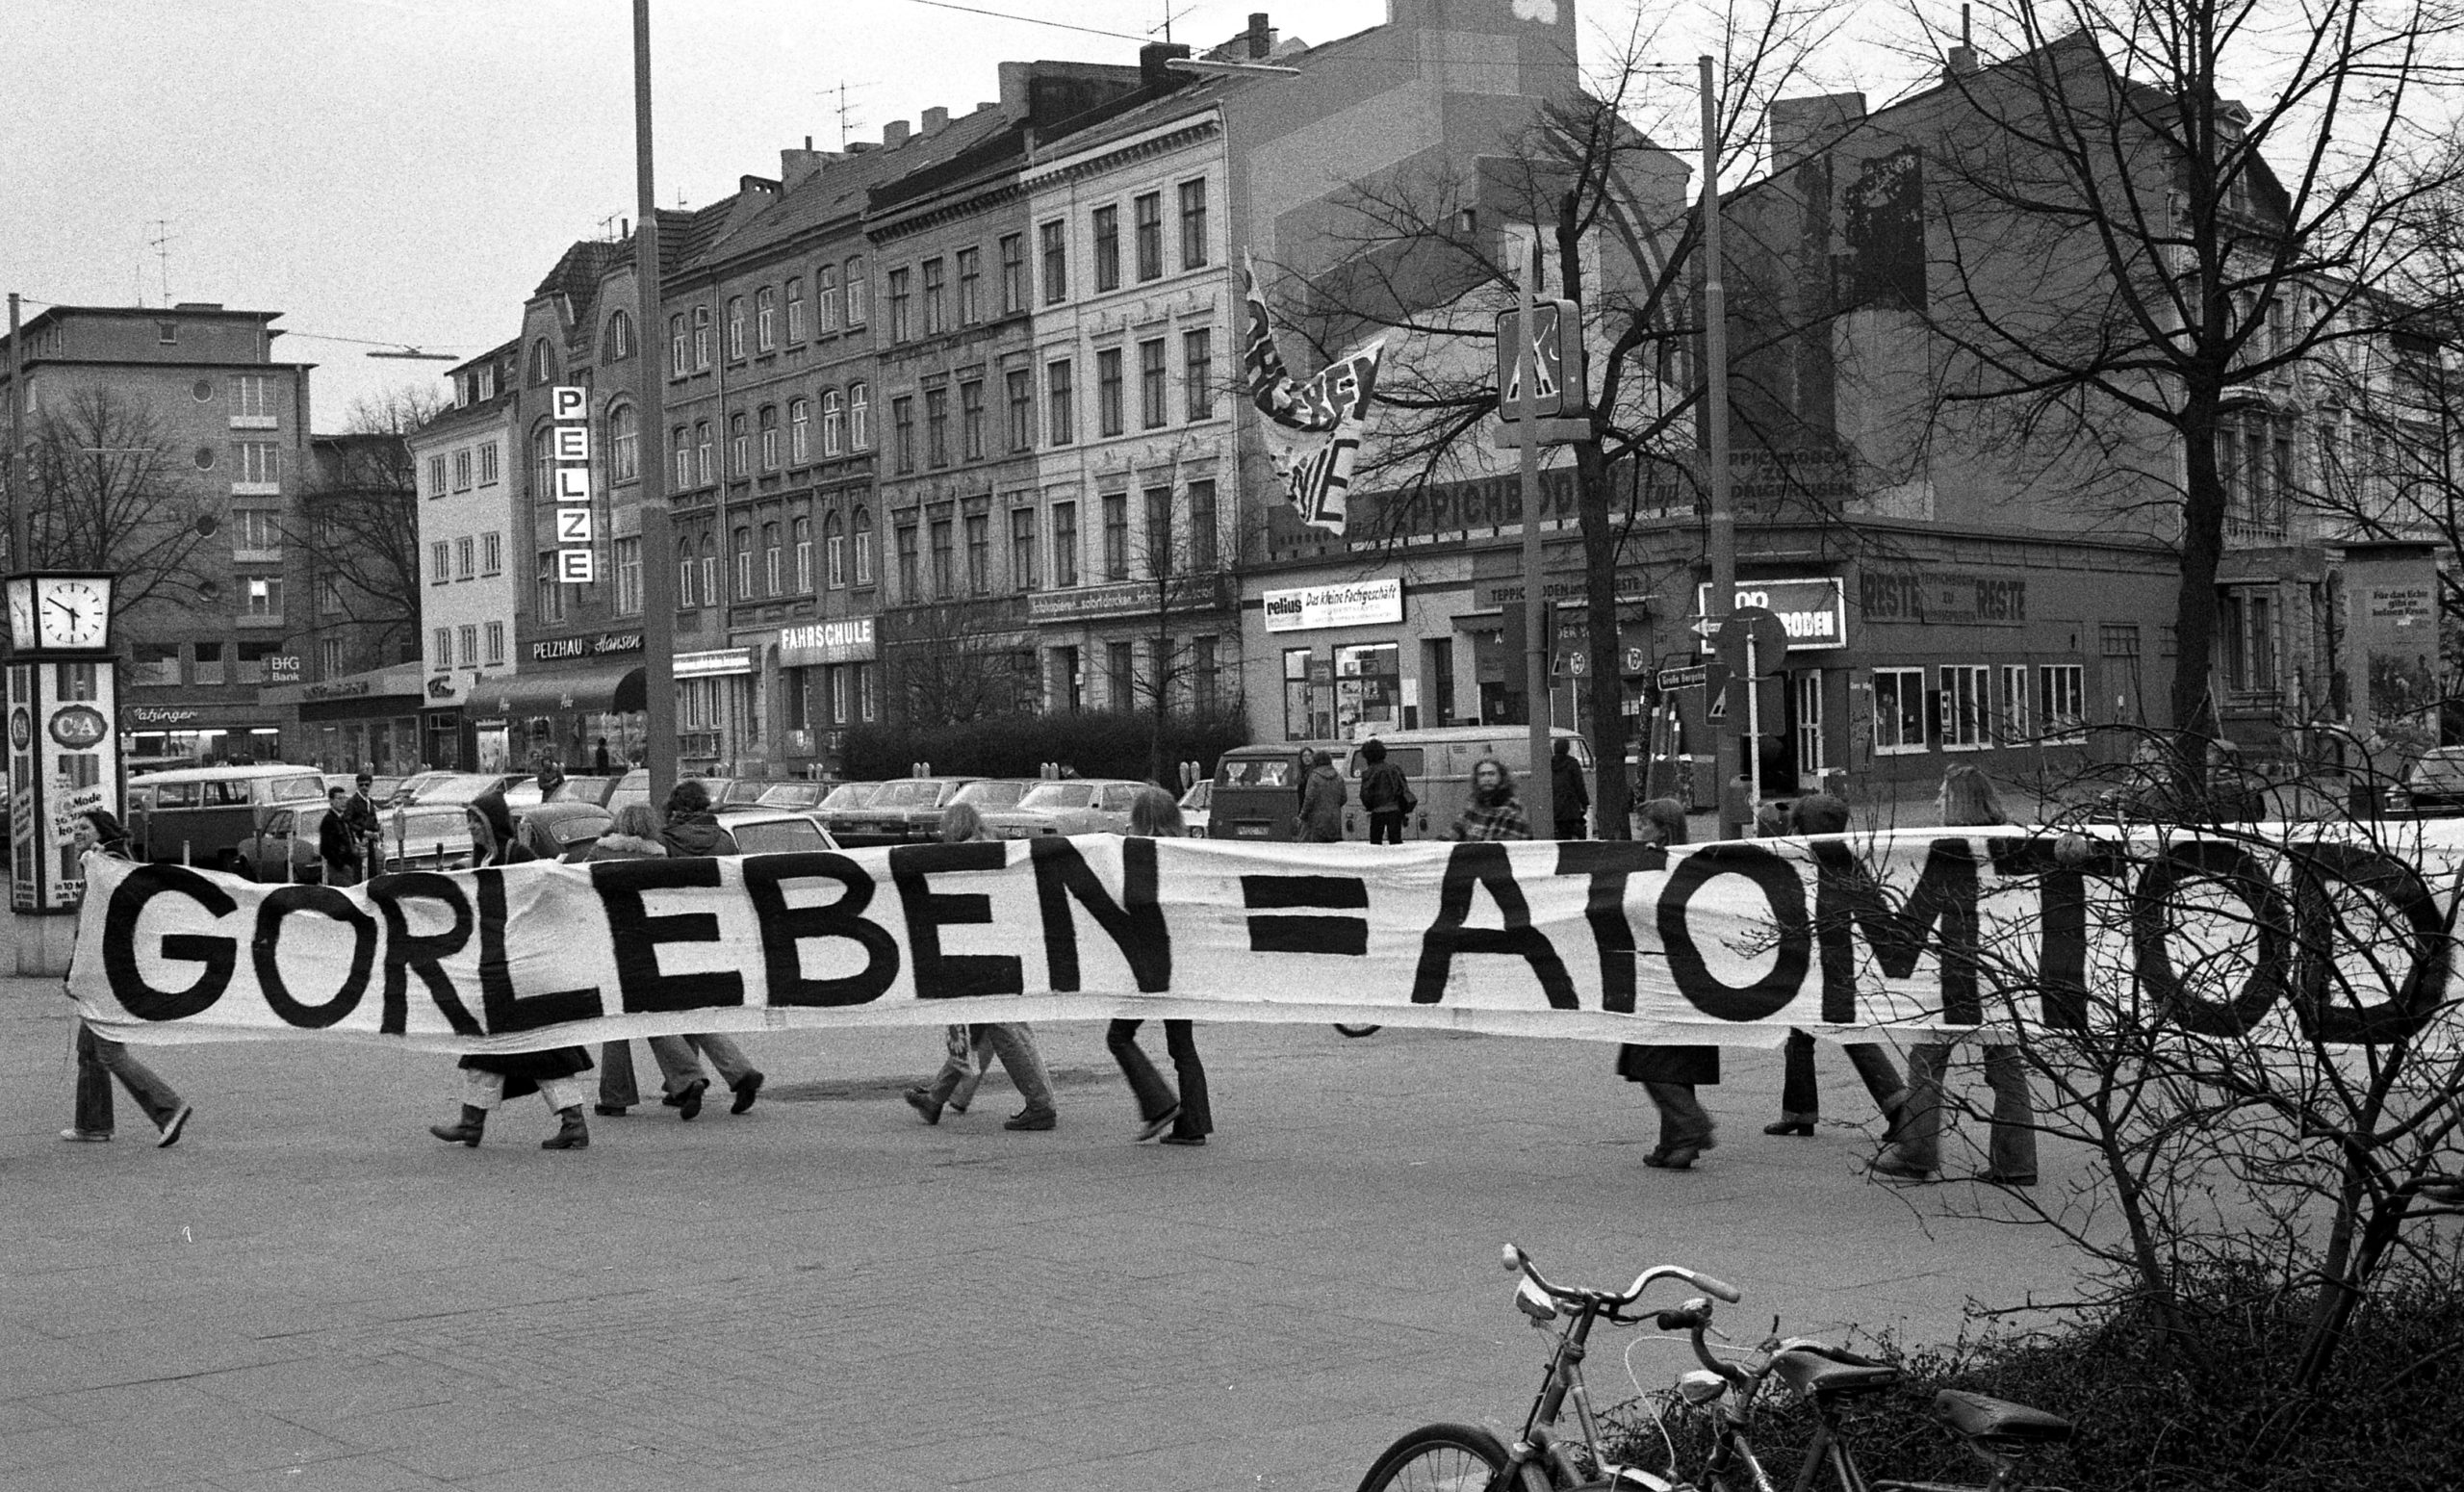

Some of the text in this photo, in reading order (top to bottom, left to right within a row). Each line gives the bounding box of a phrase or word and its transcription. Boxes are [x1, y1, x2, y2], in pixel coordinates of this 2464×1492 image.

[557, 389, 588, 579] PELZE
[1267, 598, 1302, 616] relius
[1976, 579, 2025, 621] RESTE
[782, 621, 871, 650] FAHRSCHULE
[271, 656, 300, 671] BfG
[272, 672, 299, 682] Bank
[103, 835, 1173, 1037] GORLEBEN
[1410, 838, 2452, 1042] ATOMTOD
